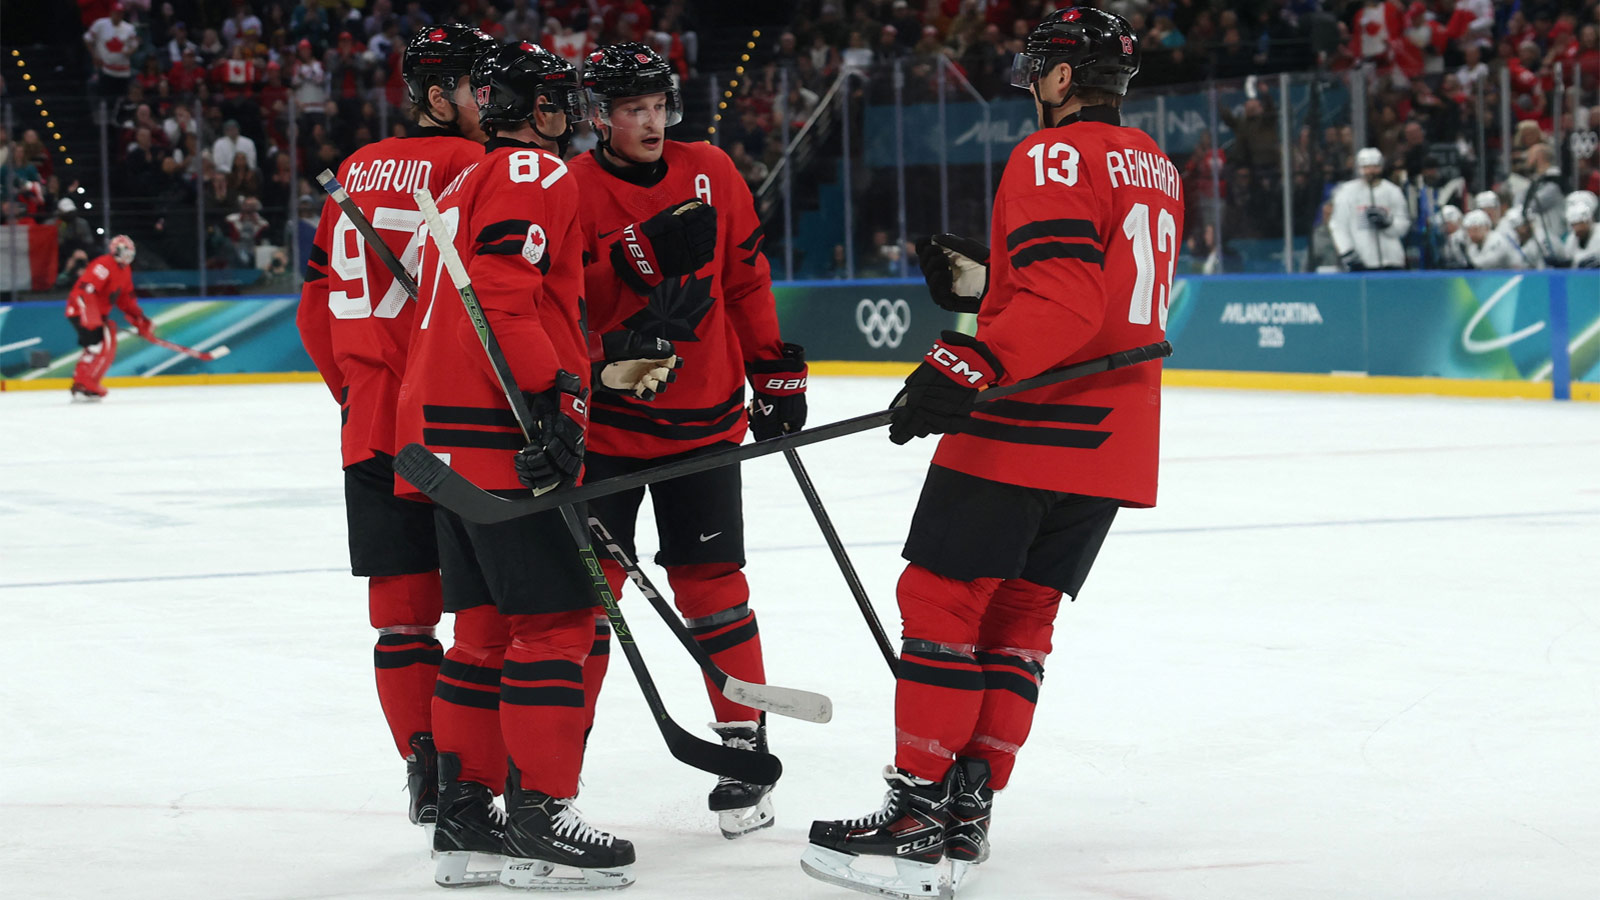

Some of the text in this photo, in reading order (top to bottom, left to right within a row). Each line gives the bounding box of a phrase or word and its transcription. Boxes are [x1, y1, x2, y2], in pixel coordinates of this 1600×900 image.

[1119, 34, 1133, 54] 13
[345, 159, 432, 194] McDAVID
[508, 150, 568, 189] 87
[1027, 142, 1080, 187] 13
[694, 173, 712, 207] A
[328, 206, 427, 319] 97
[1122, 202, 1176, 332] 13
[1221, 302, 1324, 324] MILANO CORTINA
[587, 516, 658, 599] CCM
[553, 840, 585, 856] CCM
[896, 832, 942, 855] CCM
